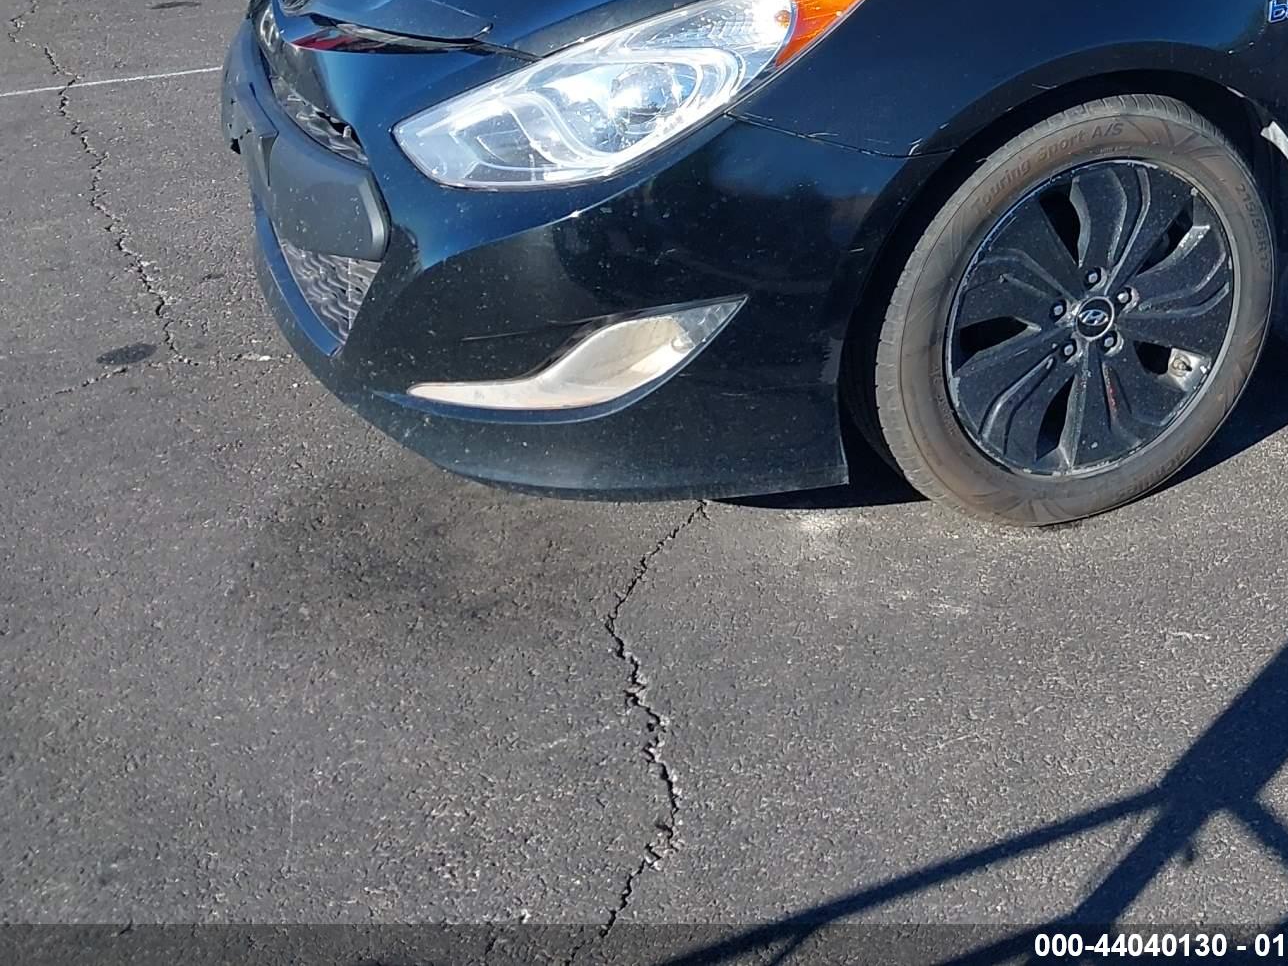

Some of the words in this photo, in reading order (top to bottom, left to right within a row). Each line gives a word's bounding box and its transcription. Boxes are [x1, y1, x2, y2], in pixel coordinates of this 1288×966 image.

[970, 155, 1031, 214] Touring
[1036, 130, 1086, 163] Sport
[1091, 119, 1125, 140] A/S
